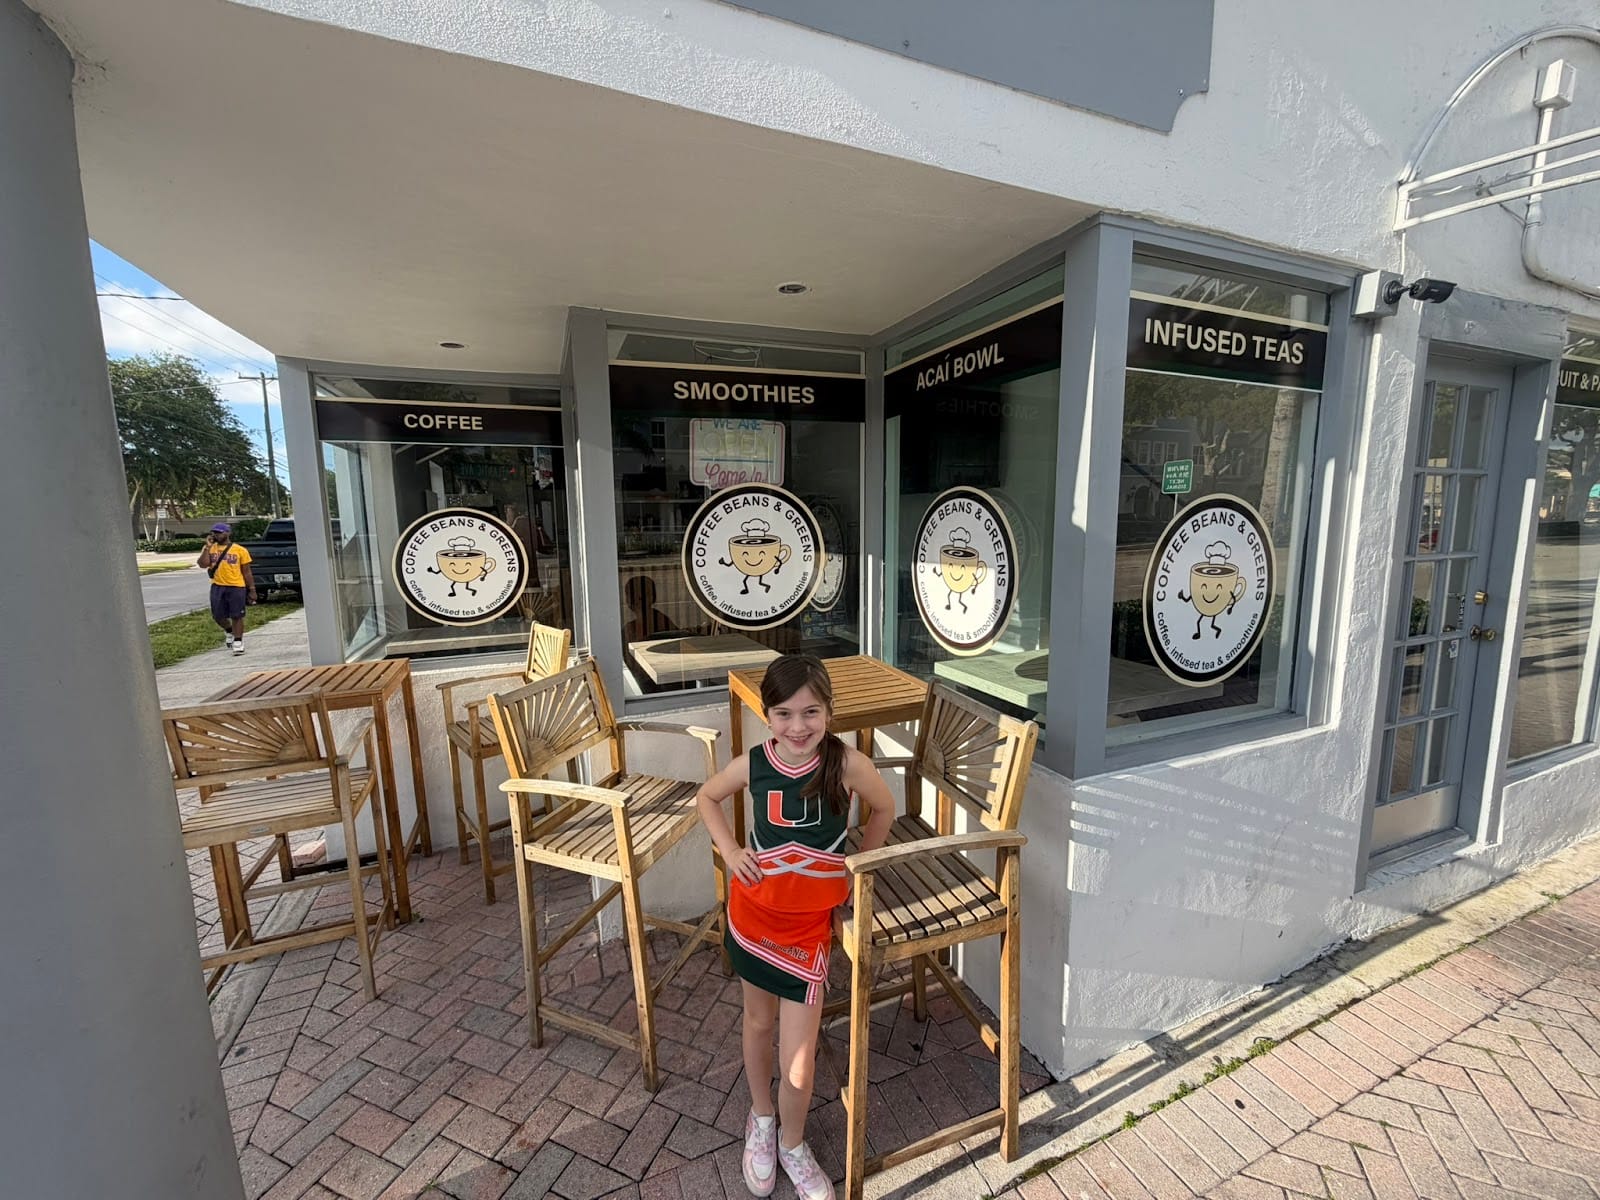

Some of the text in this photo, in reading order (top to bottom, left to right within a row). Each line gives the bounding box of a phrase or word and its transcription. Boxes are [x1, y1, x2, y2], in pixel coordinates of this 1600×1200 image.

[1144, 318, 1304, 365] INFUSED TEAS
[916, 343, 1004, 391] ACAÍ BOWL
[1580, 373, 1590, 390] &
[673, 381, 815, 404] SMOOTHIES
[404, 413, 483, 431] COFFEE
[713, 419, 762, 431] WE ARE
[406, 518, 516, 574] COFFEE BEANS & GREENS
[696, 496, 812, 568] COFFEE BEANS & GREENS
[918, 516, 938, 574] COFFEE
[938, 501, 973, 521] BEANS
[974, 507, 982, 521] &
[984, 518, 1006, 588] GREENS
[1156, 511, 1264, 602] COFFEE BEANS & GREENS
[410, 580, 427, 604] coffee,
[429, 601, 460, 616] infused
[462, 608, 476, 616] tea
[486, 579, 513, 610] smoothies
[700, 575, 718, 604] coffee,
[720, 601, 752, 618] infused
[755, 610, 769, 618] tea
[771, 606, 778, 614] &
[779, 571, 809, 610] smoothies
[953, 630, 965, 641] tea
[966, 631, 972, 641] &
[1157, 612, 1259, 671] coffee, infused tea & smoothies
[768, 791, 821, 827] U
